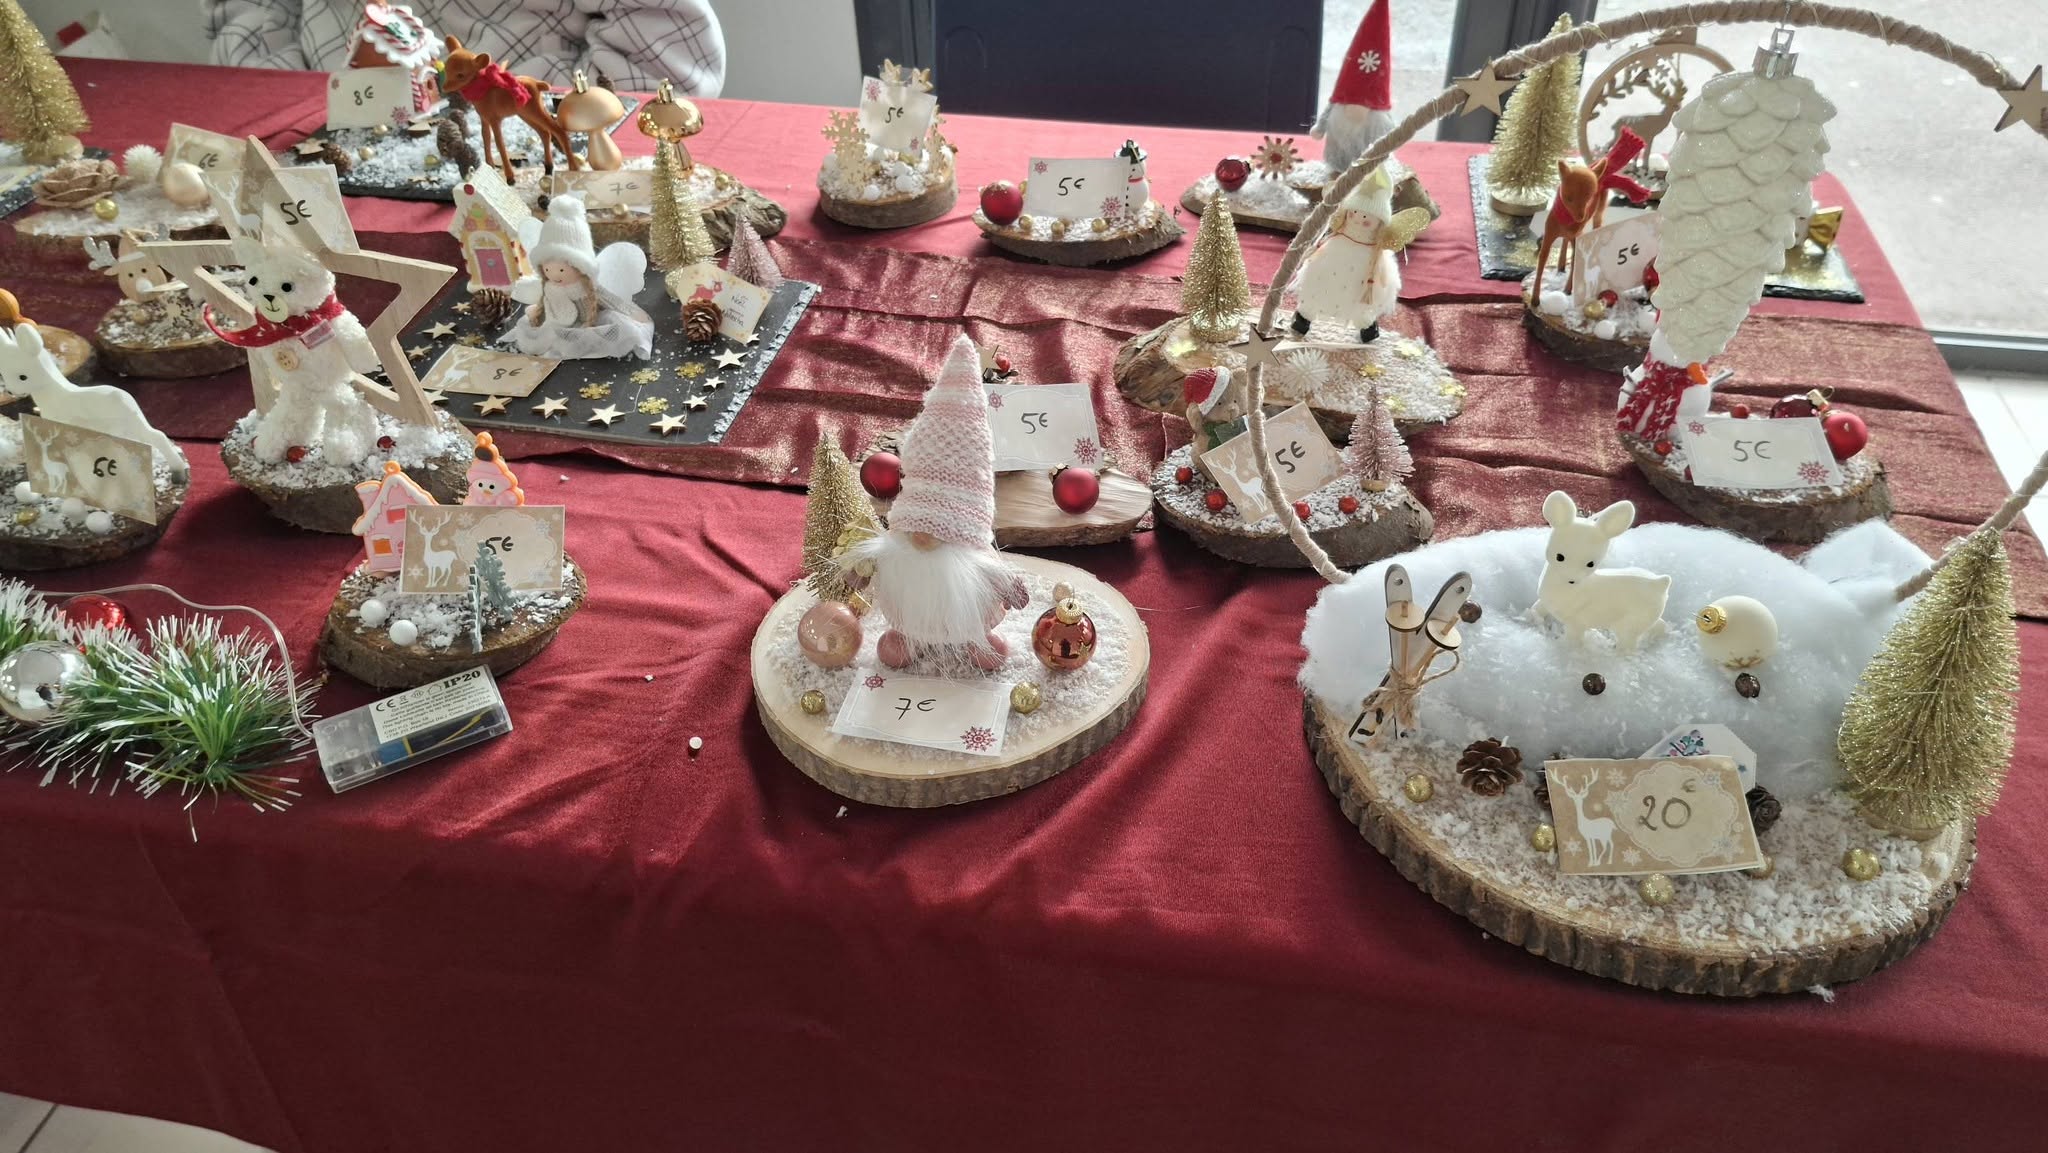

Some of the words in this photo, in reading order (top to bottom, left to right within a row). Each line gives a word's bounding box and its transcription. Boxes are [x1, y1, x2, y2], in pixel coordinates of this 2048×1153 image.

[353, 86, 374, 106] 8€
[885, 106, 904, 123] 5€
[609, 182, 639, 196] 7€
[1057, 178, 1085, 196] 5€
[280, 199, 312, 225] 5€
[1617, 243, 1640, 265] 5€
[493, 368, 523, 381] 8€
[1020, 413, 1049, 435] 5€
[1275, 441, 1306, 473] 5€
[1733, 440, 1772, 462] 5€
[485, 536, 514, 555] 5€
[443, 670, 481, 689] IP20
[894, 697, 937, 720] 7€
